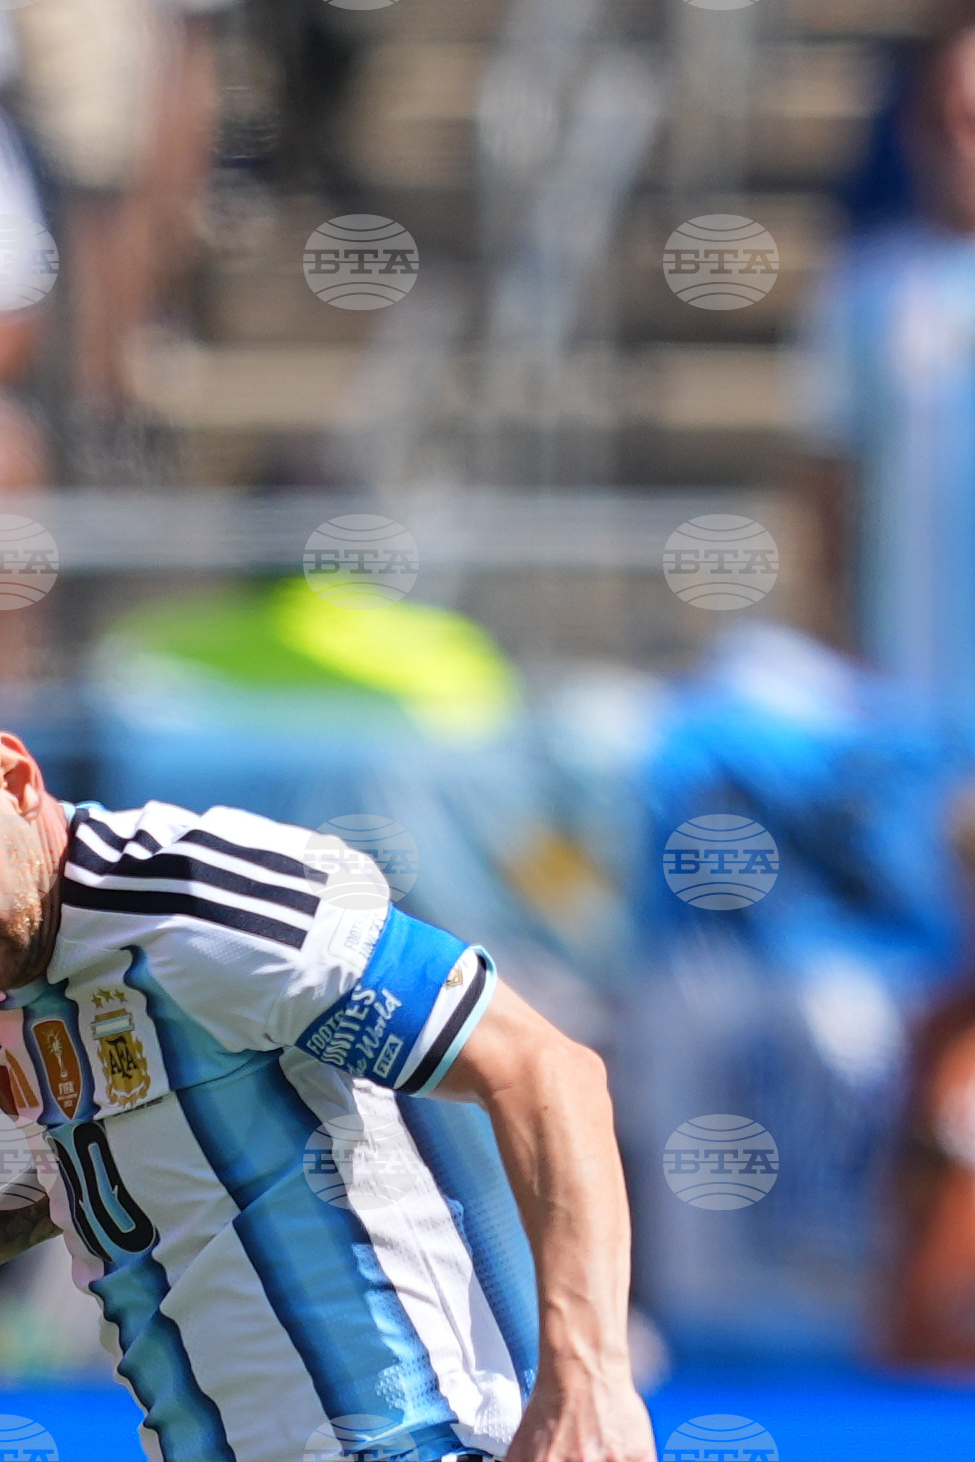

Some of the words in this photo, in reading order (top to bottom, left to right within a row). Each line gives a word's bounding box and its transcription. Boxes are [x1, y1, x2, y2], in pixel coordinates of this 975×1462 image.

[321, 984, 376, 1066] UNITES
[355, 988, 403, 1059] World
[376, 1038, 401, 1076] FIFA
